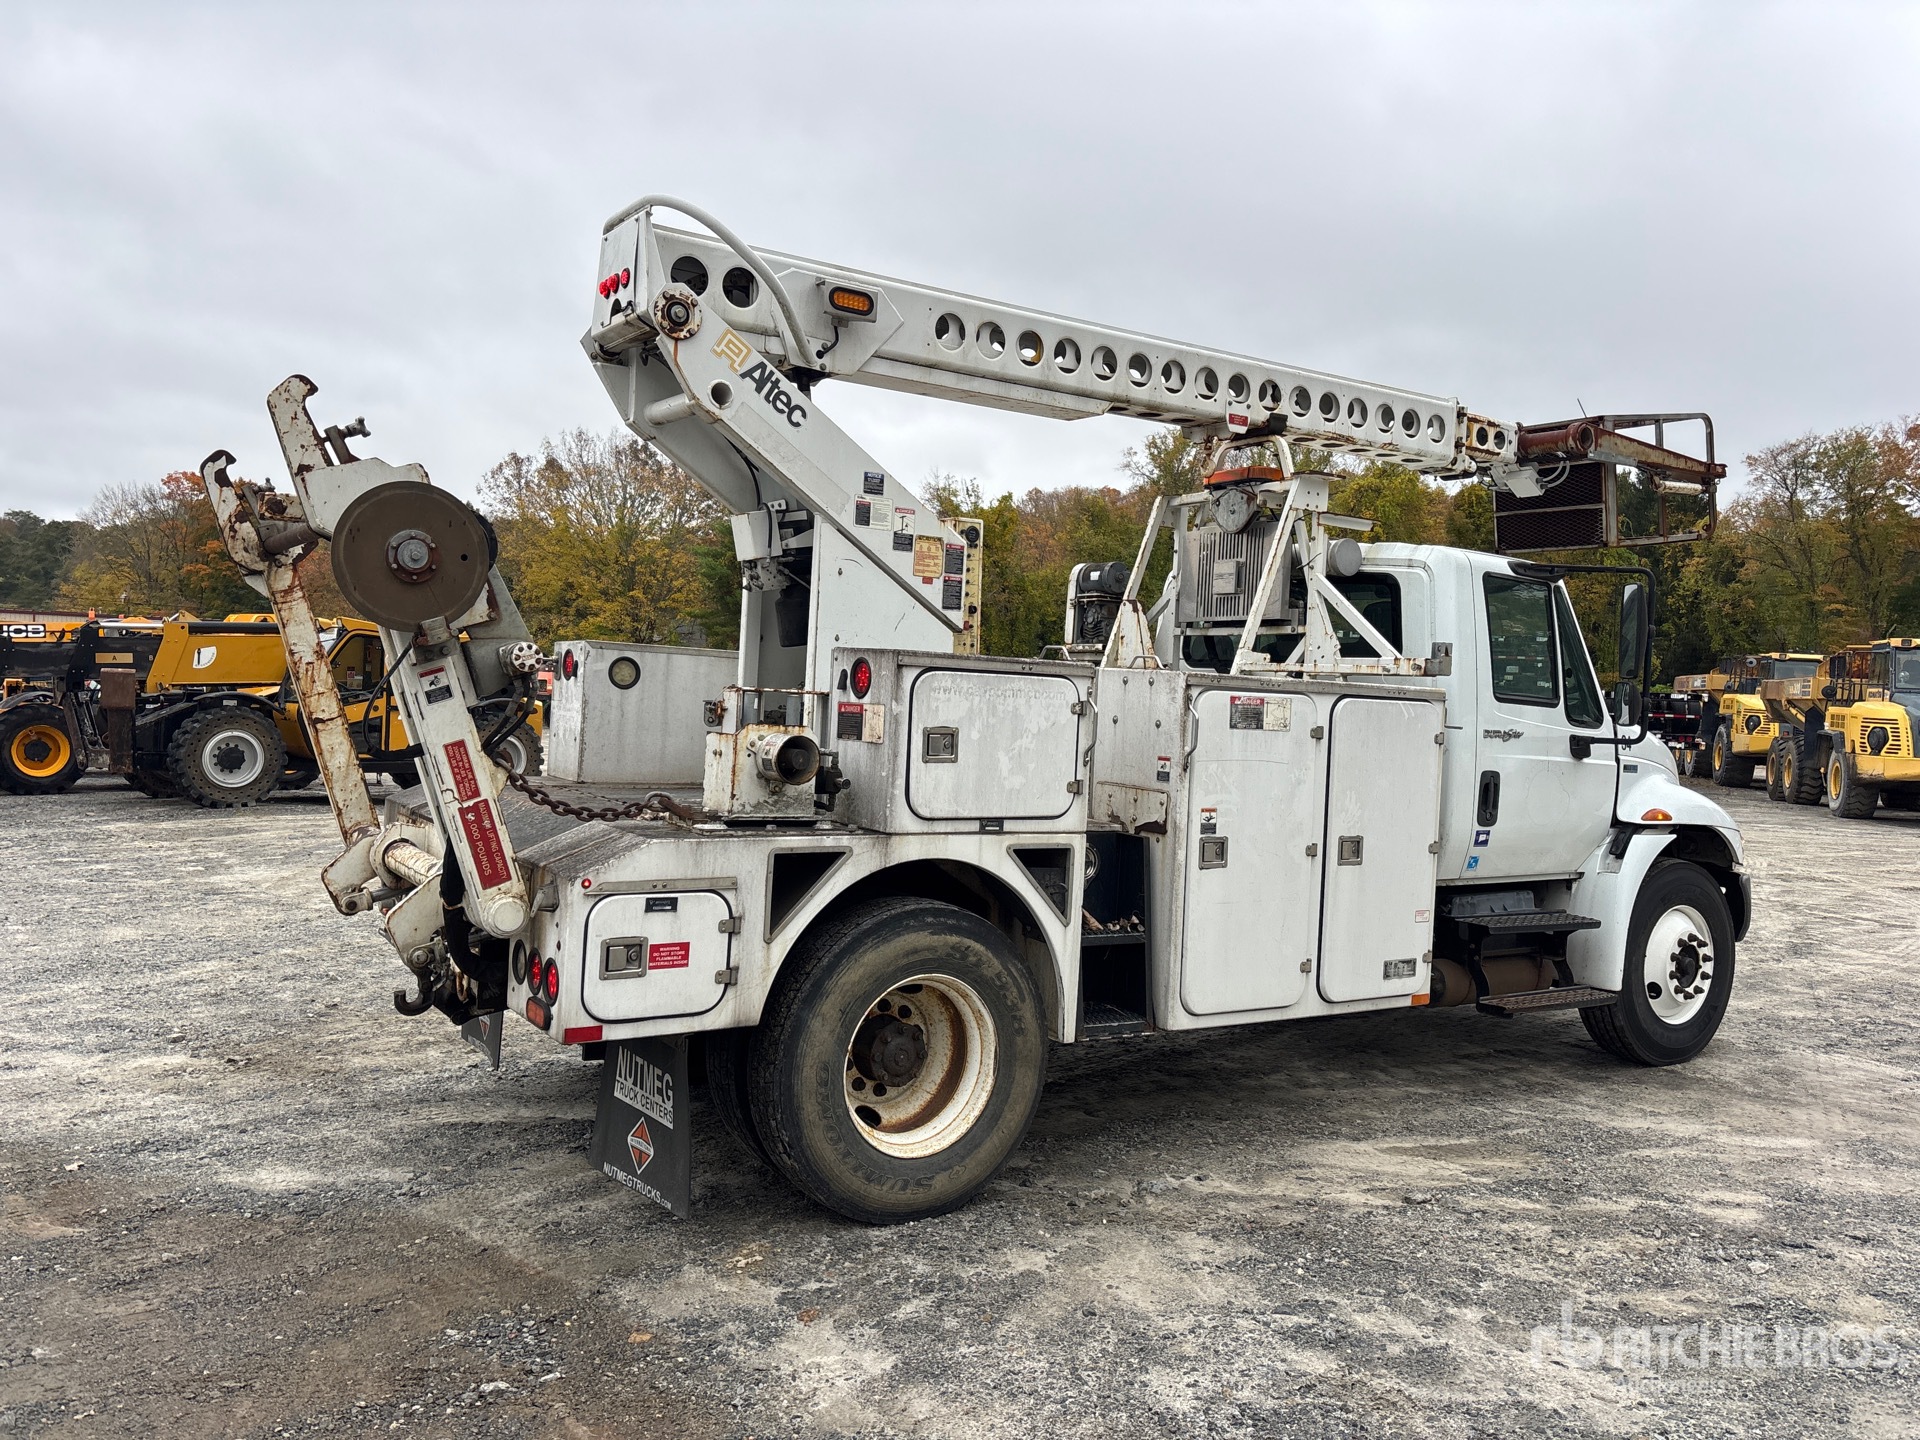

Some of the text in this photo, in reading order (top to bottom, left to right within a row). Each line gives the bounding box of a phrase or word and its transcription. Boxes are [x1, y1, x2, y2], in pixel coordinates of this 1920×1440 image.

[739, 361, 807, 428] Altec
[0, 625, 45, 638] JCB
[460, 747, 470, 767] MAXIMUM
[459, 783, 467, 800] RADIUS
[463, 778, 472, 796] TORQUE
[475, 841, 492, 876] POUNDS
[486, 830, 499, 852] LIFTING
[493, 850, 507, 879] CAPACITY
[617, 1045, 673, 1108] NUTMEG
[615, 1079, 673, 1125] TRUCK CENTERS
[603, 1161, 671, 1211] NUTMEGTRUCKS.COM
